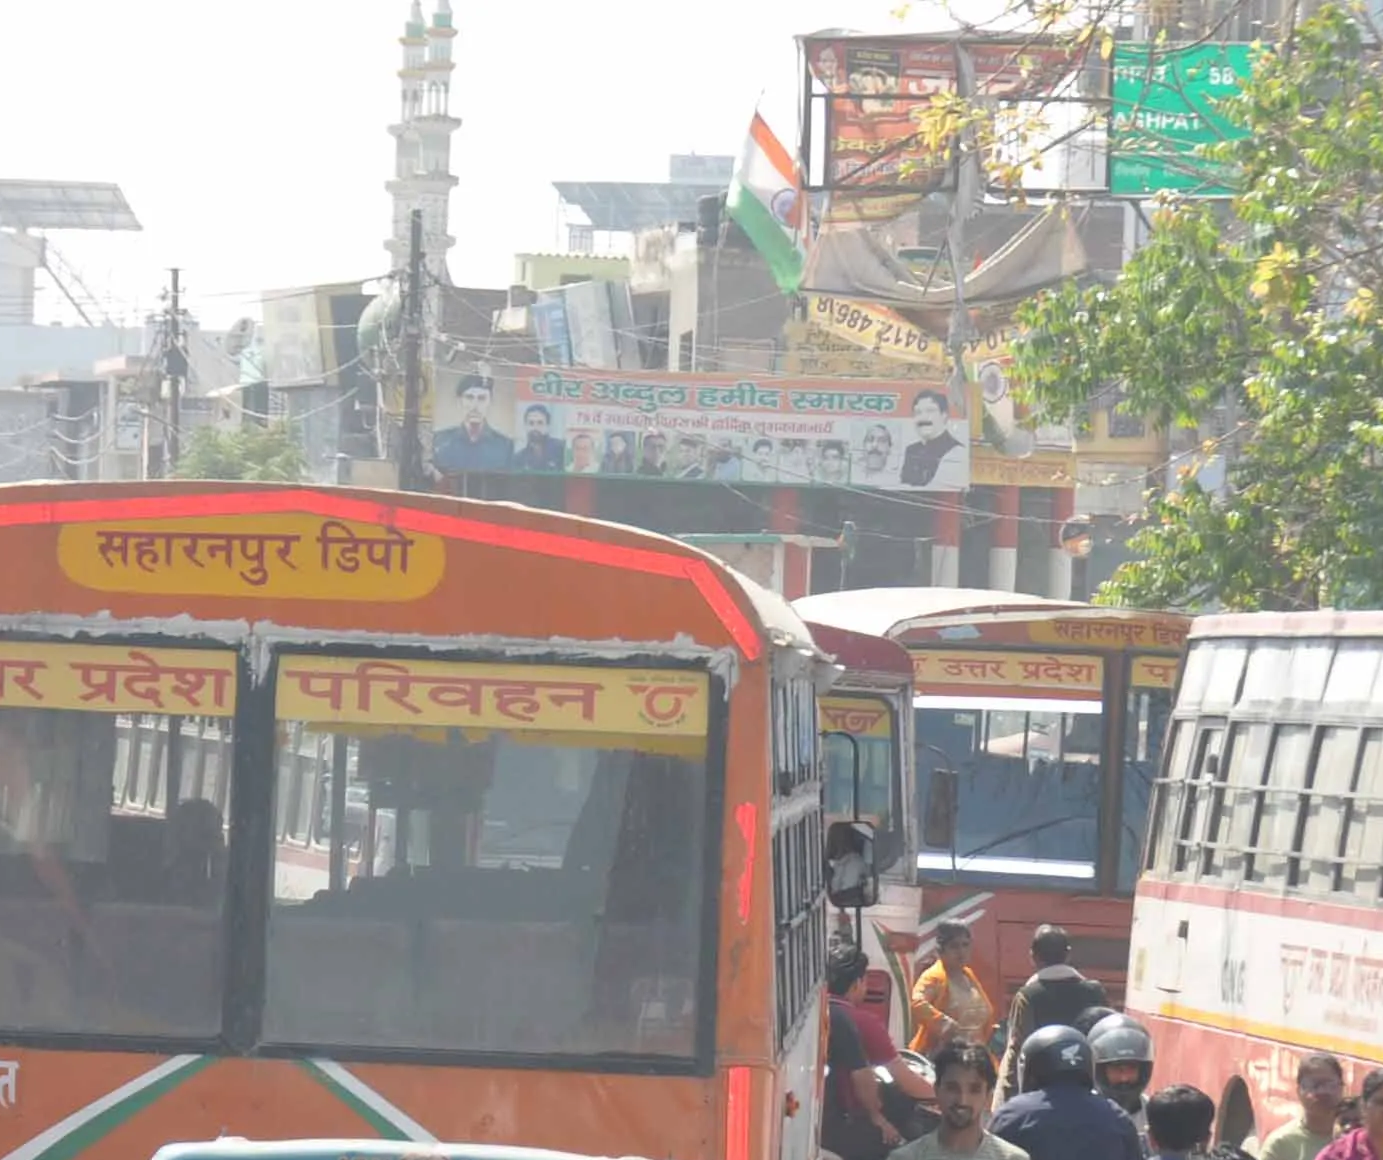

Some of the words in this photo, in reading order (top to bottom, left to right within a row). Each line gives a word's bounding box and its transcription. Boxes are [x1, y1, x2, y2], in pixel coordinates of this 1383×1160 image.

[1209, 66, 1234, 85] 58
[1113, 111, 1200, 130] AGHPAT
[531, 371, 584, 399] वीर
[590, 381, 689, 413] अब्दुल
[695, 381, 782, 410] हमीद
[789, 389, 901, 412] स्मारक
[96, 530, 301, 586] सहारनपुर
[316, 520, 415, 575] डिपो
[1054, 620, 1146, 645] सहारनपुर
[938, 658, 1007, 680] उत्तर
[1018, 656, 1097, 683] प्रदेश
[69, 650, 233, 709] प्रदेश
[284, 661, 606, 723] परिवहन
